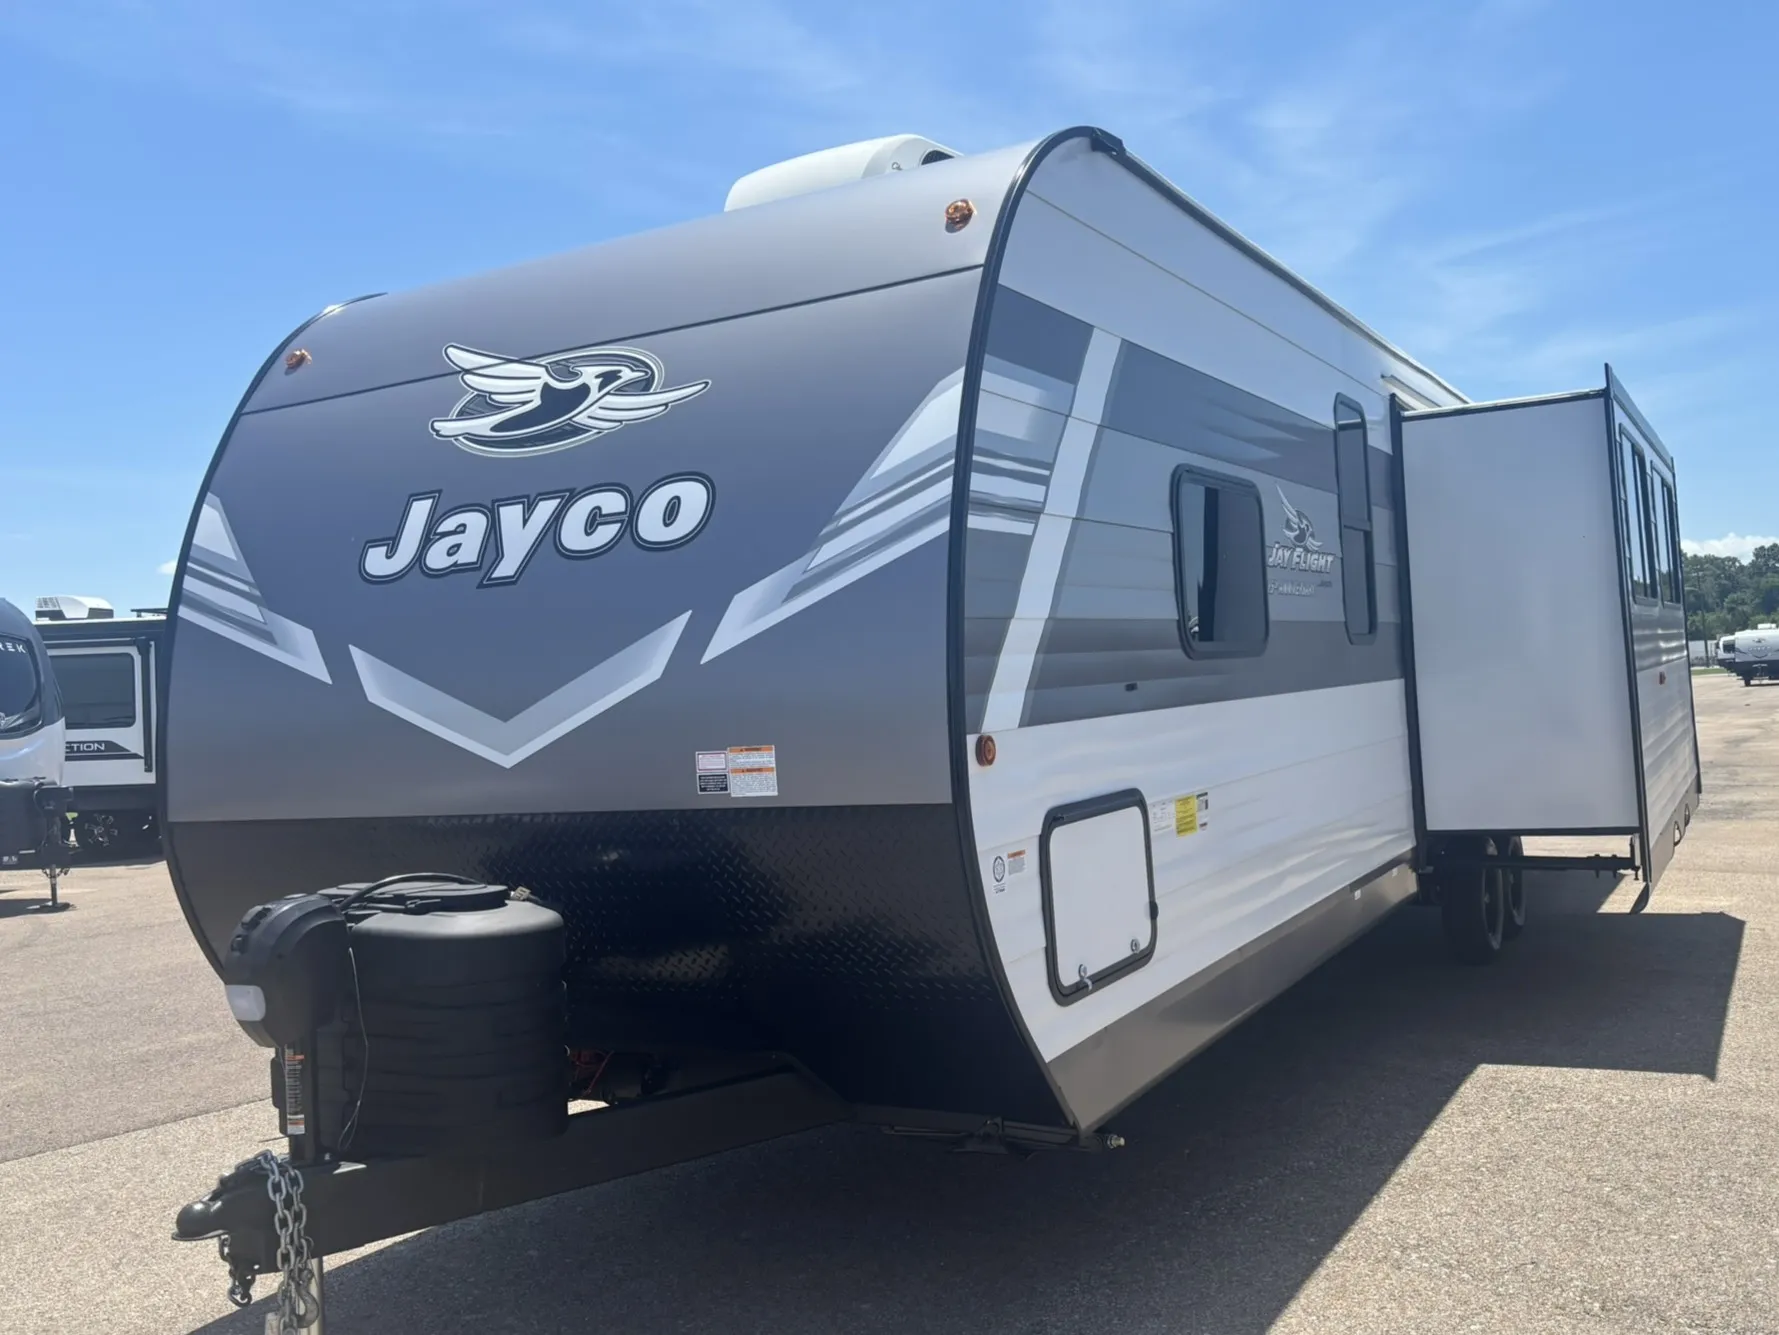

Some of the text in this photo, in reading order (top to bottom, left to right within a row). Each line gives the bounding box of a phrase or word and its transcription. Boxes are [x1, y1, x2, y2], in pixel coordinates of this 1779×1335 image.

[359, 472, 716, 588] Jayco
[1267, 543, 1335, 573] JAY FLIGHT
